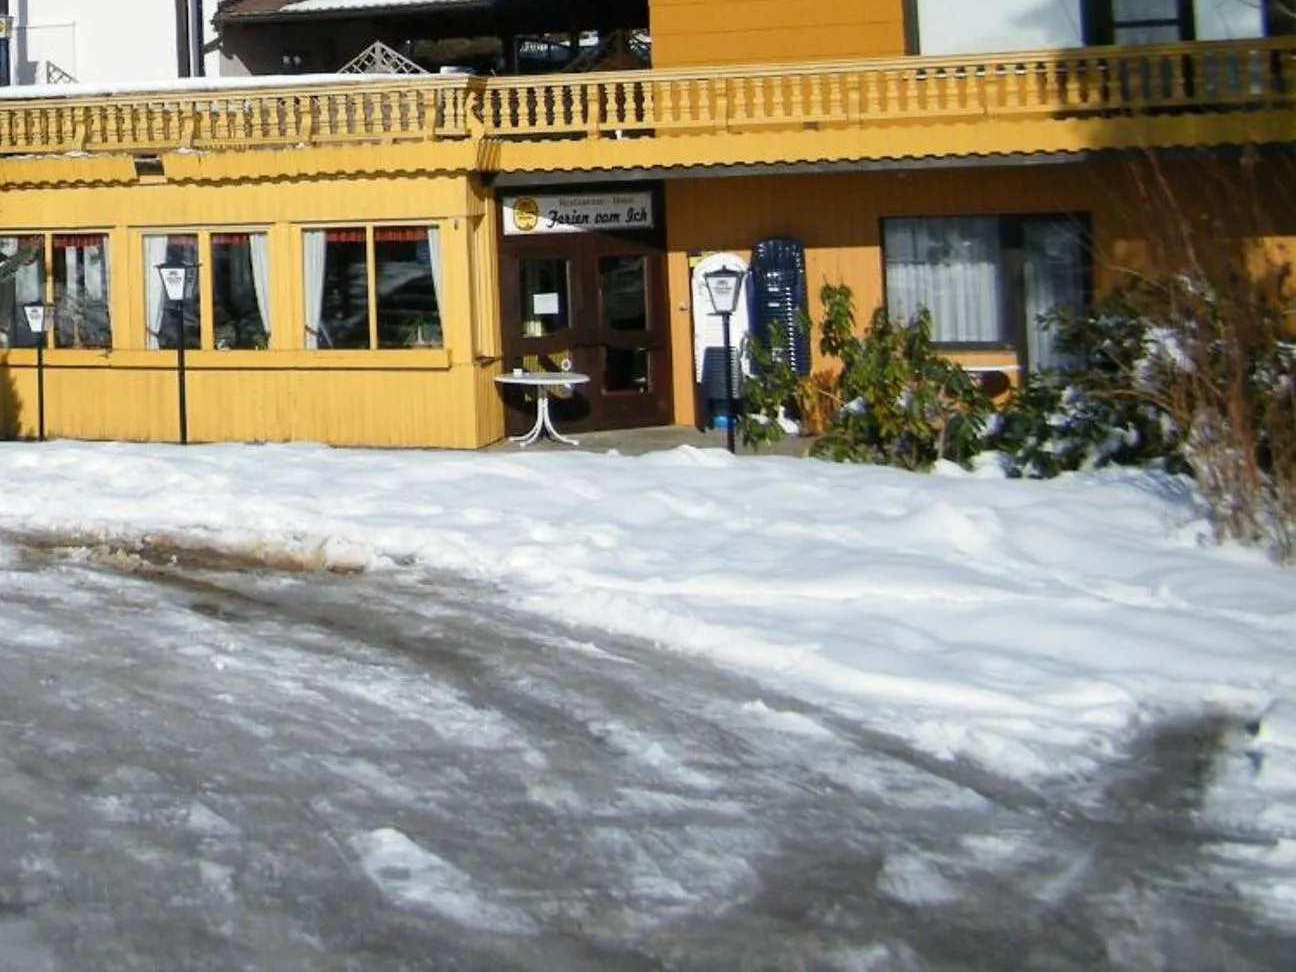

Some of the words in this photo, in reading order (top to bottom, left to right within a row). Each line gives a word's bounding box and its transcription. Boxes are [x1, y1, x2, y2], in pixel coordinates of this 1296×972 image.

[546, 209, 590, 228] Ferien
[594, 213, 621, 224] vom
[625, 207, 648, 223] Ich
